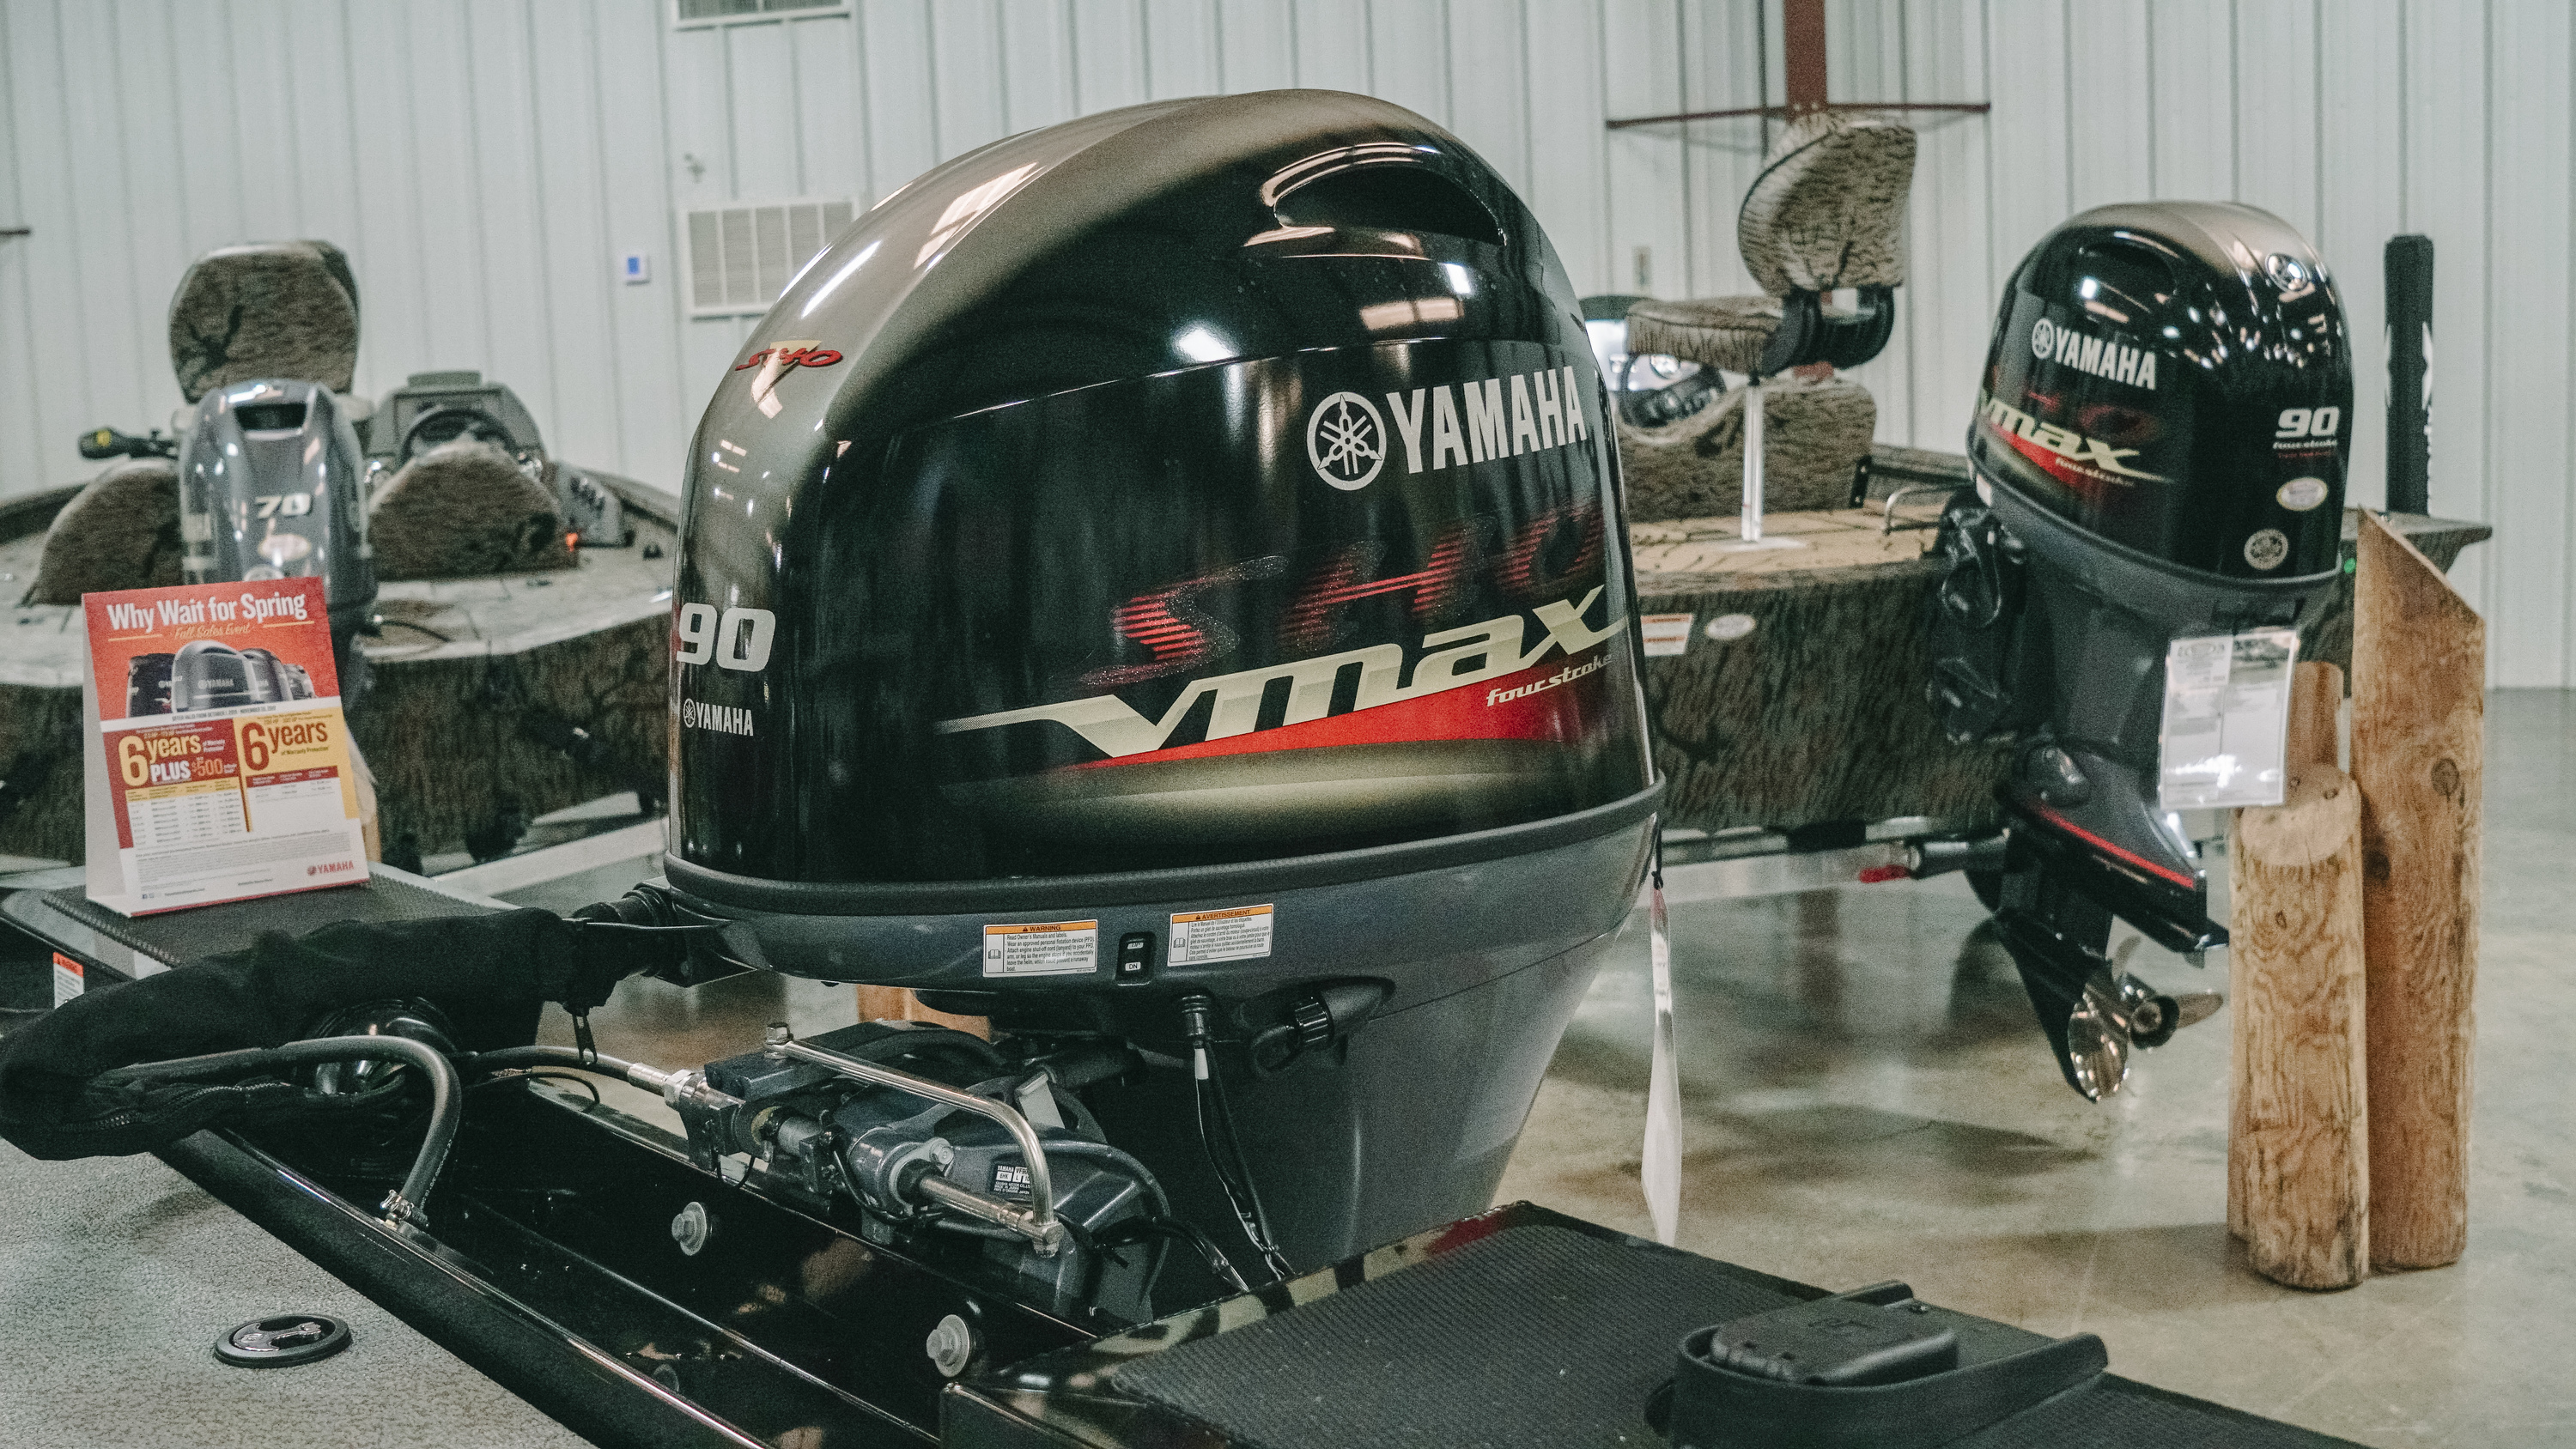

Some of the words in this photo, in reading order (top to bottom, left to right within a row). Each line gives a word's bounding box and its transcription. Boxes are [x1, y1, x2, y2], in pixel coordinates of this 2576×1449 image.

[2055, 328, 2156, 391] YAMAHA
[1386, 366, 1589, 474] YAMAHA
[2275, 406, 2340, 438] 90
[256, 494, 310, 518] 70
[106, 603, 155, 634] Why
[156, 598, 205, 626] Wait
[208, 596, 238, 621] for
[240, 591, 308, 624] Spring
[226, 623, 252, 636] Event
[676, 602, 776, 672] 90
[696, 701, 754, 737] YAMAHA
[118, 735, 149, 786] 6
[145, 735, 202, 765] years
[241, 722, 270, 771] 6
[267, 722, 328, 754] years
[150, 761, 191, 782] PLUS
[191, 758, 223, 777] $500
[317, 860, 354, 874] YAMAHA
[1202, 909, 1250, 919] AVERTISSEMENT
